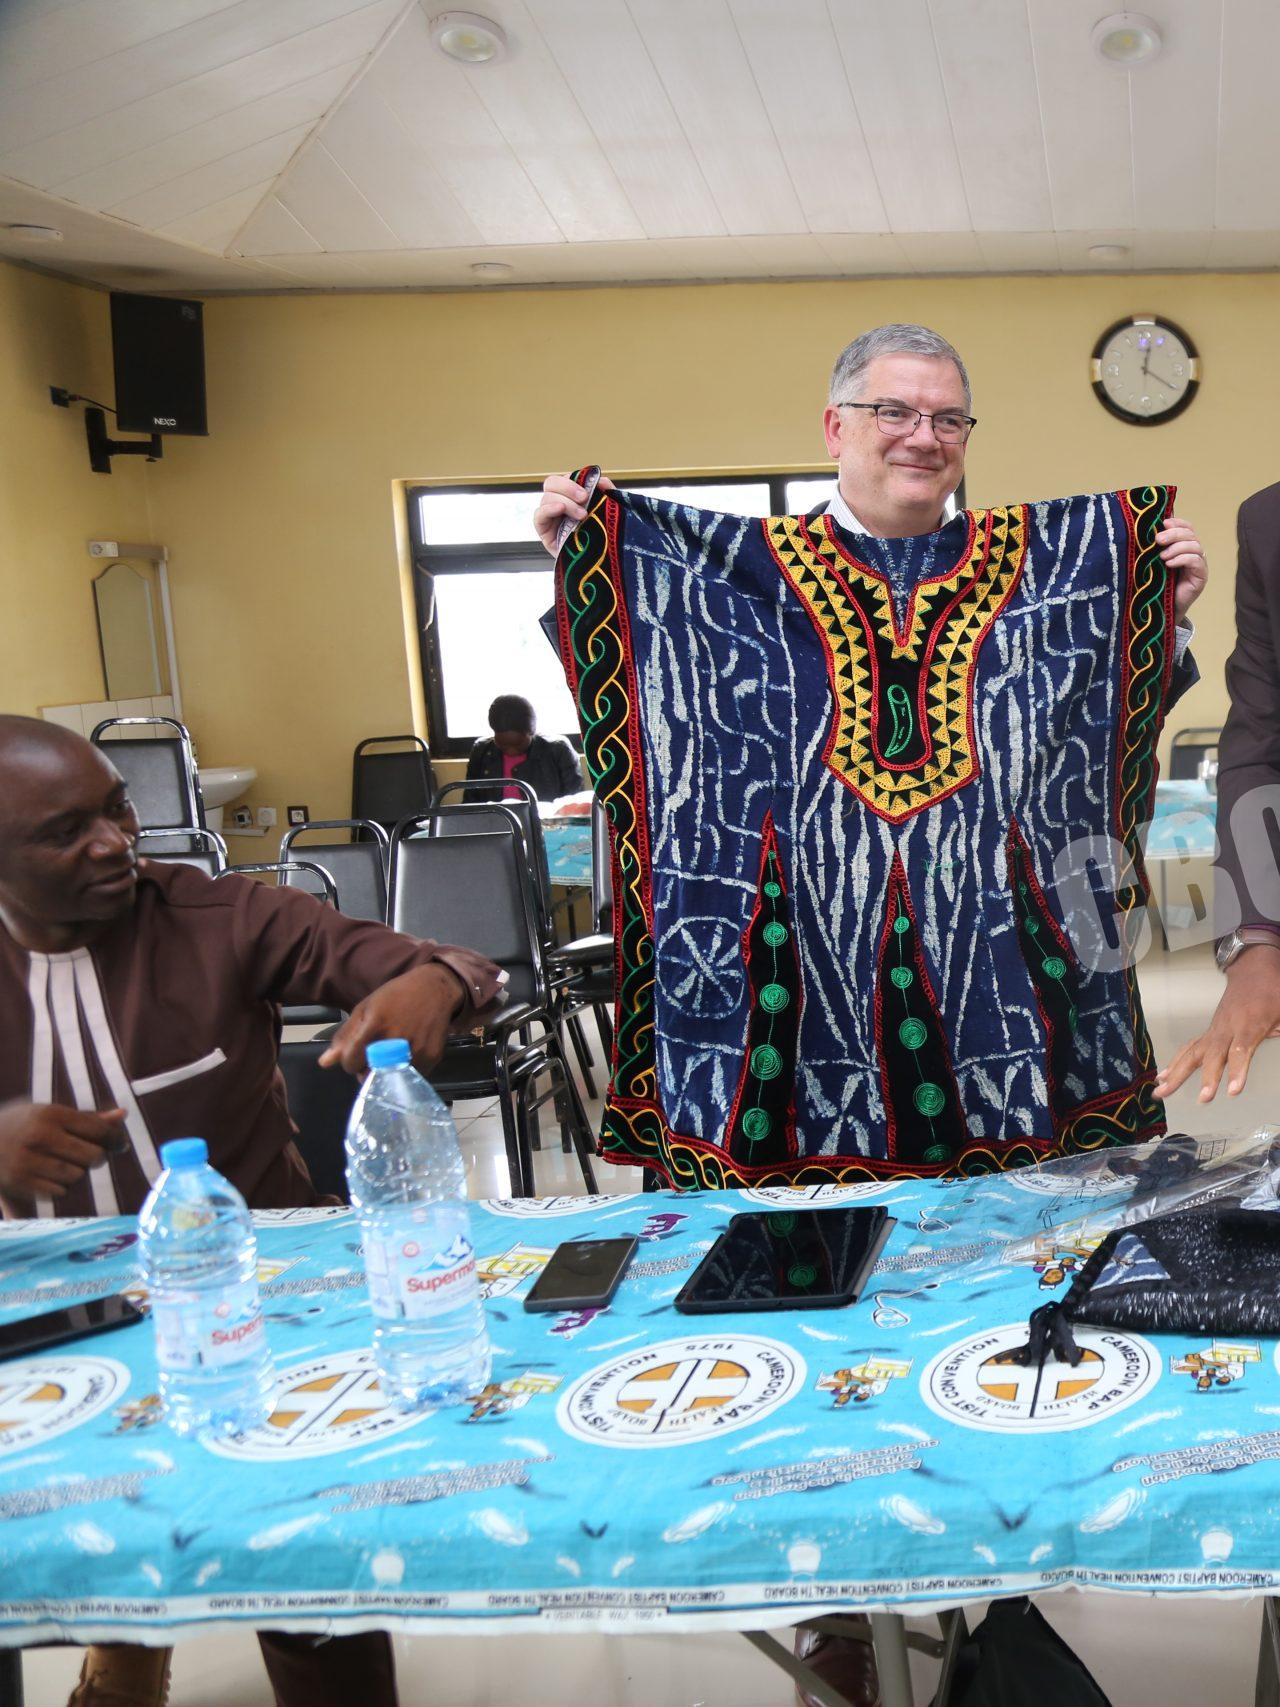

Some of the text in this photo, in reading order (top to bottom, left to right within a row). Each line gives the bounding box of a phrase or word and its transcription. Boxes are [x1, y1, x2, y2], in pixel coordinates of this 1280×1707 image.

[685, 1343, 734, 1351] 1975
[757, 1352, 785, 1403] CAMEROON
[940, 1336, 1140, 1418] CAMEROON BAP TIST CONVENTION
[975, 1396, 1021, 1411] BOARD
[1113, 1455, 1150, 1472] Love
[1211, 1459, 1237, 1470] the
[1142, 1465, 1211, 1485] Provision
[1076, 1572, 1113, 1581] HEALTH
[1115, 1573, 1175, 1583] CONVENTION
[1178, 1573, 1216, 1584] BAPTIST
[1219, 1573, 1273, 1584] CAMEROON
[765, 1579, 1002, 1599] CAMEROON BAPTIST CONVENTION HEALTH BOARD
[210, 1598, 246, 1609] BOARD
[670, 1591, 724, 1605] CAMEROON
